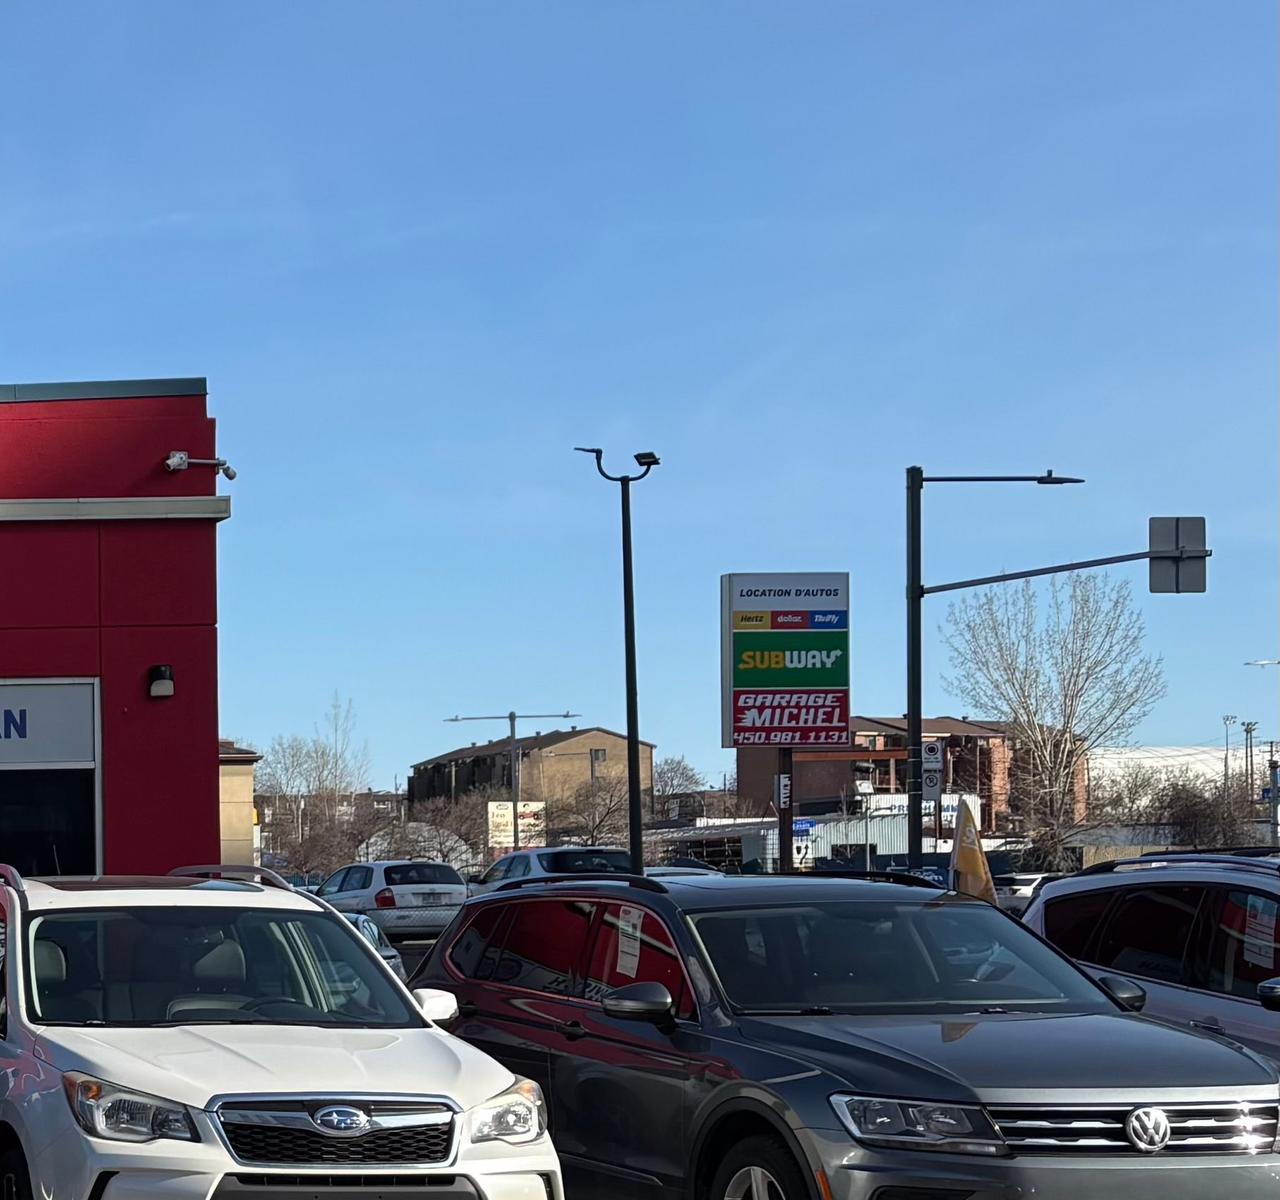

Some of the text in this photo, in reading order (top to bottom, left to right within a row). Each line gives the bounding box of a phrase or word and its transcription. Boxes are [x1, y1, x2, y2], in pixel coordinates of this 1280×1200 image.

[740, 588, 840, 598] LOCATION D'AUTOS
[740, 615, 765, 624] Hertz
[738, 649, 843, 670] SUBWAY
[738, 693, 844, 707] GARAGE
[740, 707, 846, 726] MICHEL
[733, 731, 849, 744] 450.981.1131
